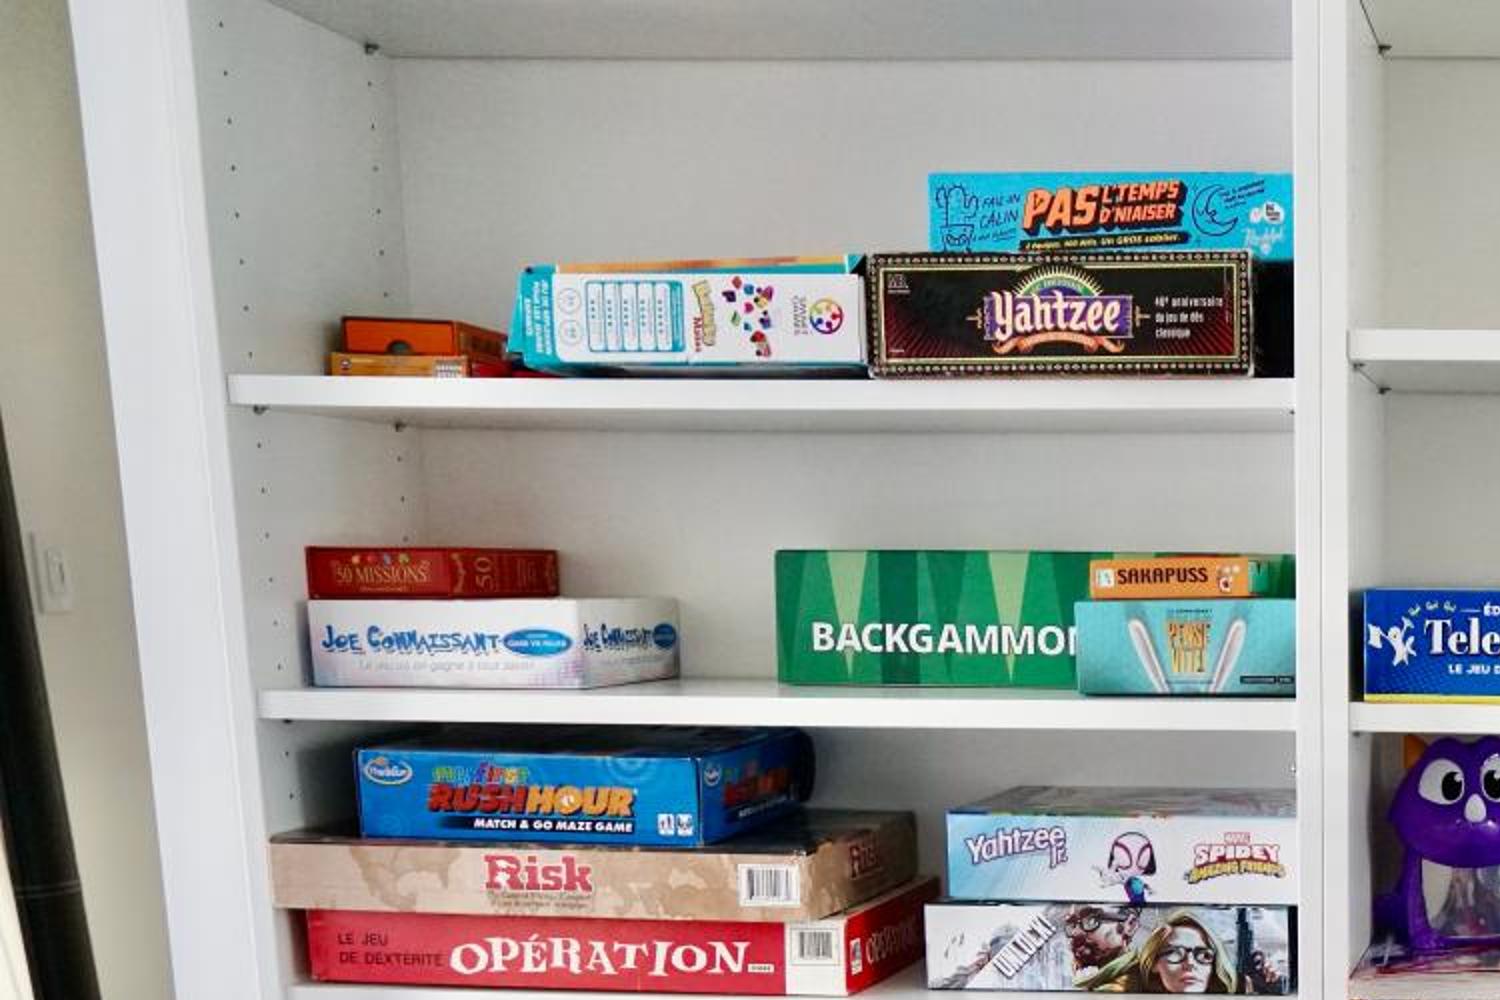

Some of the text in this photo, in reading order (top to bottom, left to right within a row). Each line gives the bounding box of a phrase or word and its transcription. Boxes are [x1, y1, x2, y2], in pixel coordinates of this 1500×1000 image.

[1101, 181, 1180, 203] L'TEMPS
[1022, 184, 1101, 230] PAS
[1099, 203, 1177, 222] D'NIAISER
[990, 290, 1122, 341] Yahtzee
[354, 563, 429, 584] MISSIONS
[1117, 567, 1209, 585] SAKAPUSS
[1448, 664, 1463, 675] LE
[1466, 664, 1491, 675] JEU
[428, 783, 635, 817] RUSH HOUR
[473, 818, 633, 833] MATCH & GO MAZE GAME
[964, 826, 1068, 865] Yahtzee
[1195, 844, 1280, 867] SPIDEY
[483, 854, 593, 893] Risk
[337, 933, 389, 947] LE JEU
[339, 951, 358, 965] DE
[450, 933, 751, 976] OPÉRATION
